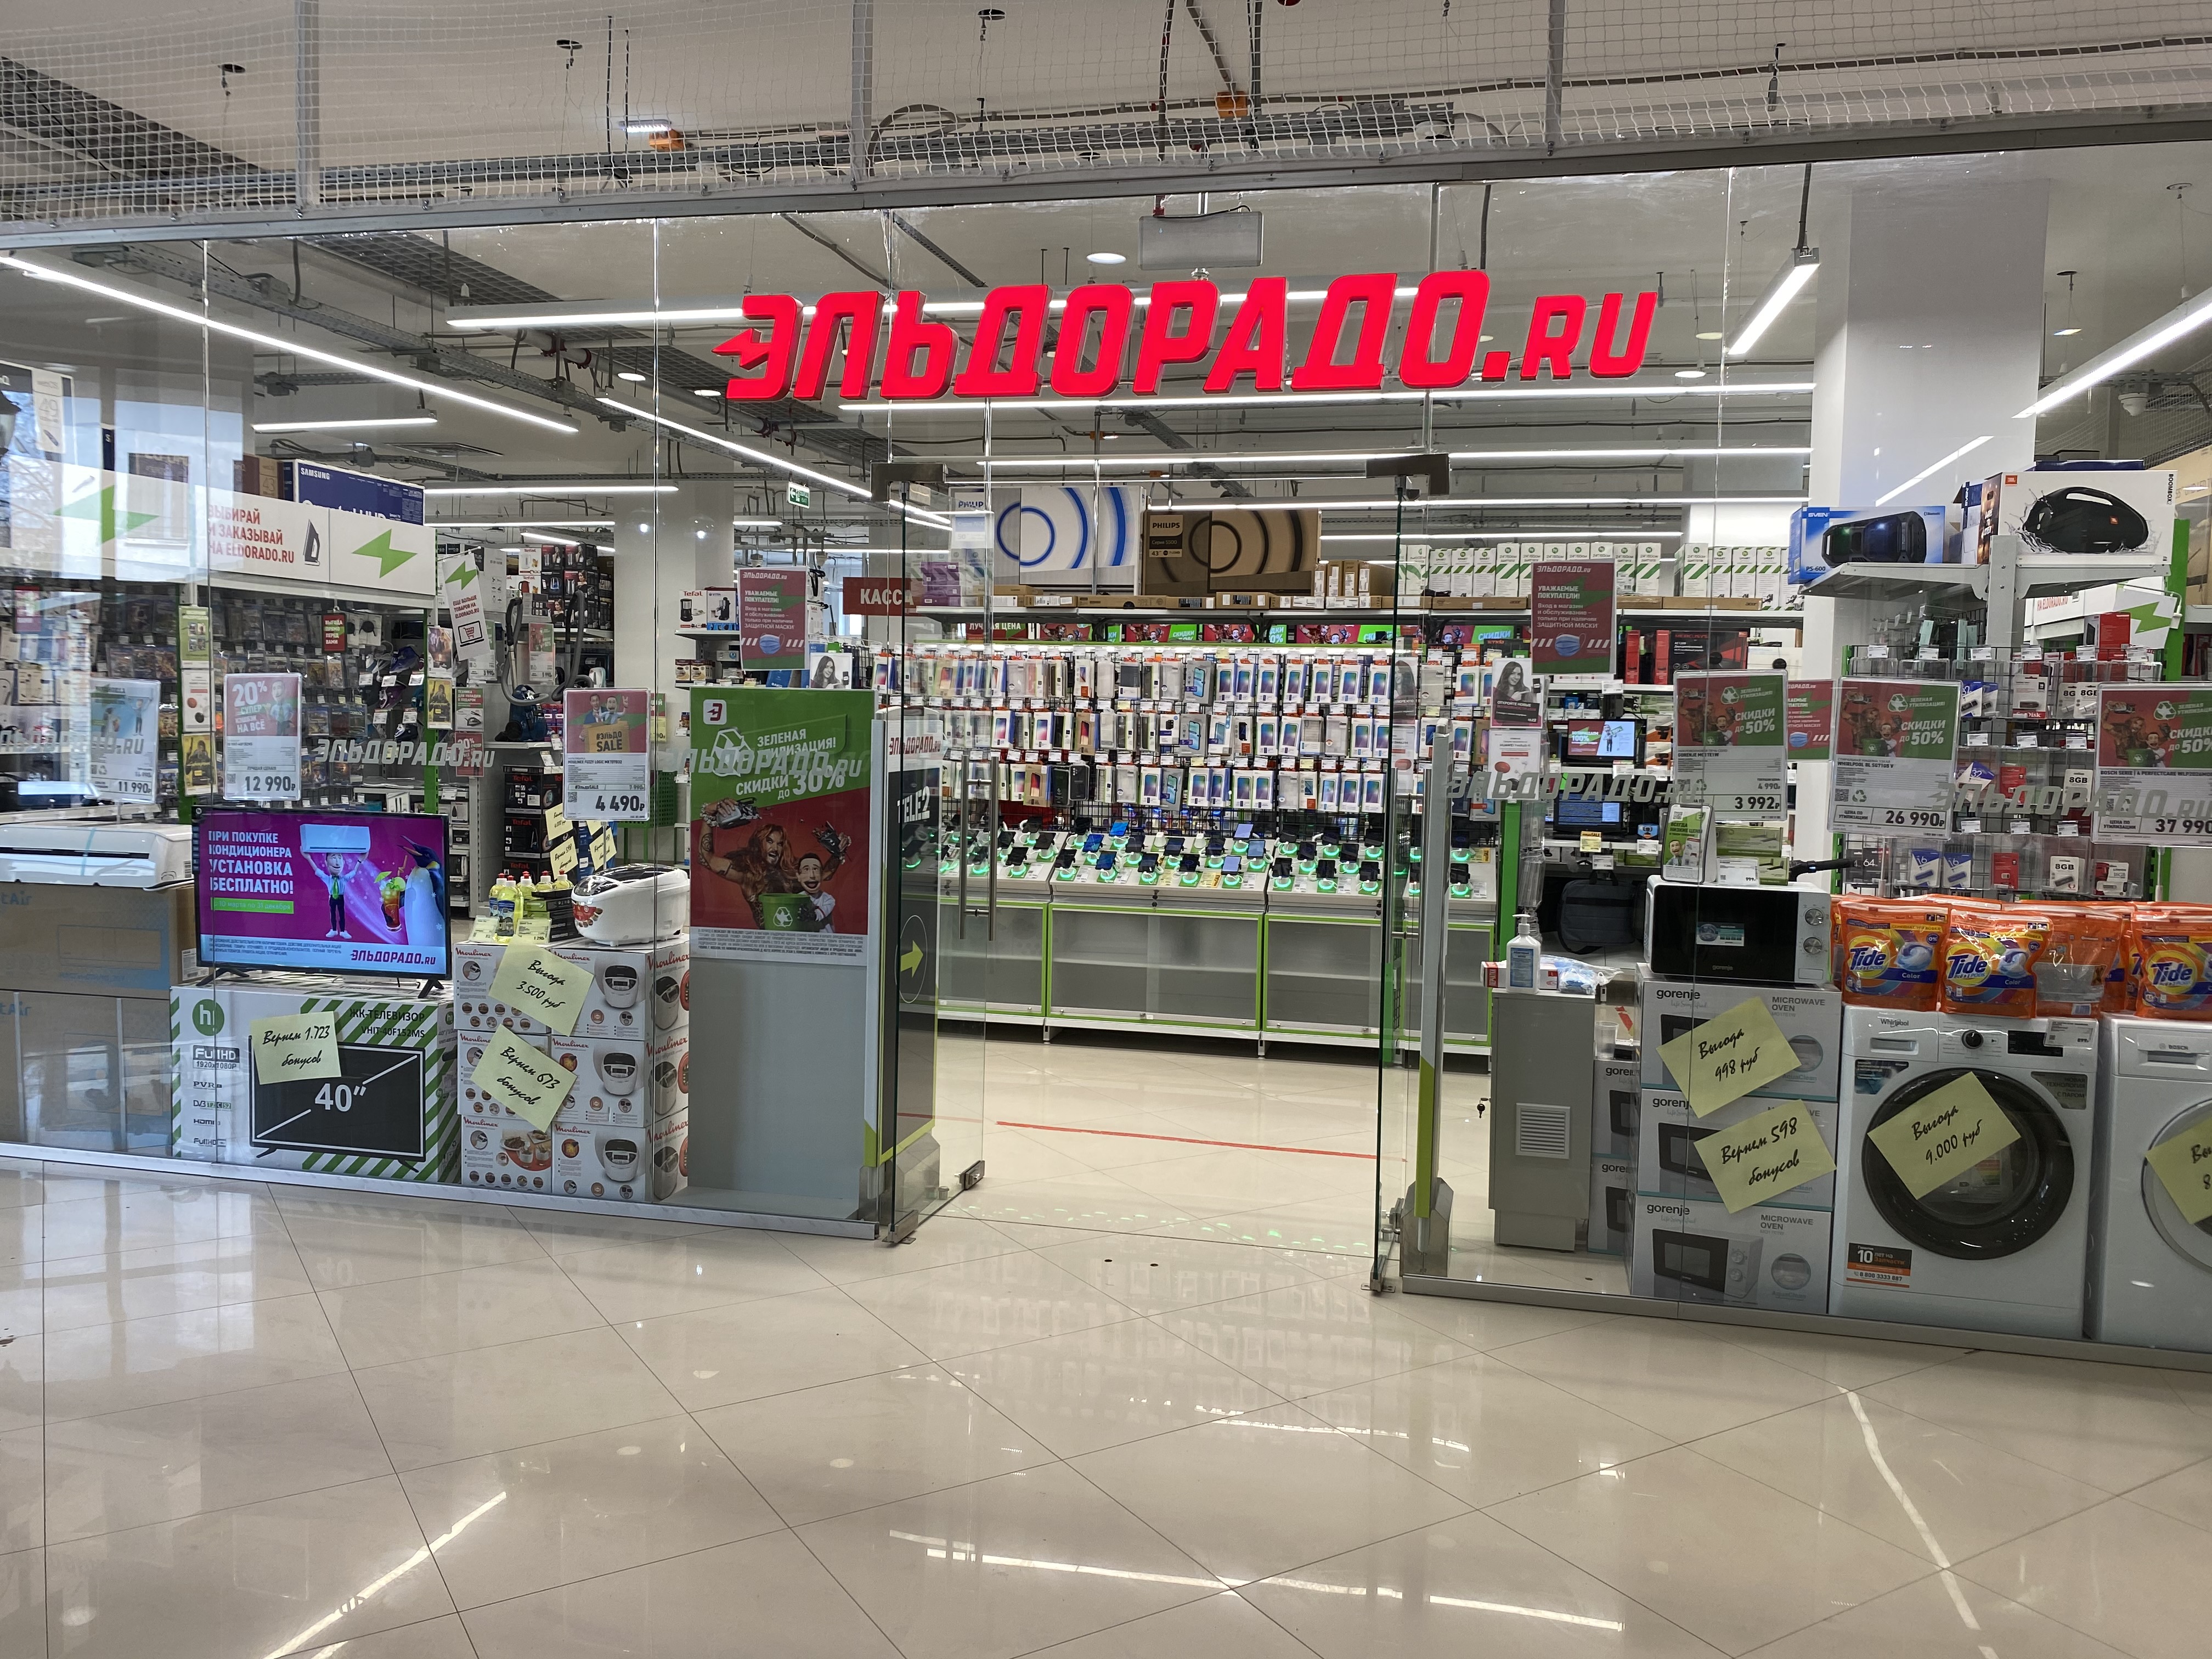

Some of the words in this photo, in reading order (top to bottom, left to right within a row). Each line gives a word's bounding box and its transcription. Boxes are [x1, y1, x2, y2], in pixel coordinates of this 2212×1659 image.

[713, 269, 1657, 401] ЭЛЬДОРАДО.RU
[300, 467, 330, 480] SAMSUNG
[209, 504, 261, 524] ВЫБИРАЙ
[1152, 522, 1181, 530] PHILIPS
[219, 524, 283, 545] ЗАКАЗЫВАЙ
[226, 543, 295, 564] ELDORADO.RU
[742, 572, 788, 580] ЭЛЬДОРАДО.RU
[1536, 565, 1592, 573] ЭЛЬДОРАДО.RU
[860, 588, 914, 606] КАССА
[1001, 623, 1022, 631] ЦЕНА
[1172, 629, 1195, 639] СКИДКИ
[1478, 630, 1511, 640] СКИДКИ
[232, 680, 268, 707] 20%
[240, 703, 263, 715] СУПЕР
[1735, 708, 1775, 721] СКИДКИ
[236, 723, 249, 734] НА
[249, 718, 266, 732] ВСЁ
[1745, 719, 1775, 735] 50%
[1900, 719, 1946, 731] СКИДКИ
[596, 730, 623, 741] #ЭЛЬДО
[757, 728, 806, 748] ЗЕЛЕНАЯ
[1899, 735, 1910, 743] до
[1910, 730, 1944, 746] 50%
[311, 738, 495, 768] ЭЛЬДОРАДО.RU
[596, 740, 623, 752] SALE
[2168, 743, 2180, 752] до
[792, 764, 845, 796] 30%
[1971, 769, 1982, 778] 32
[118, 781, 128, 792] 11
[245, 776, 261, 792] 12
[735, 774, 789, 796] СКИДКИ
[1443, 770, 1697, 804] ЭЛЬДОРАДО.RU
[595, 795, 606, 811] 4
[897, 786, 930, 823] TELE2
[1734, 796, 1743, 810] 3
[1885, 810, 1905, 825] 26
[2155, 819, 2176, 833] 37
[208, 830, 229, 842] ПРИ
[232, 831, 279, 844] ПОКУПКЕ
[208, 844, 292, 858] КОНДИЦИОНЕРА
[208, 859, 293, 877] УСТАНОВКА
[1863, 858, 1875, 867] 64
[1916, 856, 1927, 866] 16
[1949, 857, 1960, 866] 16
[210, 877, 294, 895] БЕСПЛАТНО!
[264, 903, 291, 912] декабря
[349, 950, 437, 966] ЭЛЬДОРАДО.RU
[455, 947, 493, 957] Moulinex
[1850, 947, 1886, 971] Tide
[527, 960, 566, 985] Выгода
[1948, 956, 1988, 980] Tide
[2151, 962, 2193, 985] Tide
[515, 980, 546, 1000] 3.500
[540, 997, 566, 1008] руб
[1656, 989, 1701, 1001] gorenje
[1772, 996, 1826, 1006] MICROWAVE
[349, 1008, 425, 1022] ЖК-ТЕЛЕВИЗОР
[1880, 1018, 1909, 1028] Whirlpool
[262, 1030, 301, 1046] Вернем
[304, 1025, 331, 1041] 1.723
[552, 1037, 589, 1048] Moulinex
[1698, 1028, 1745, 1059] Выгода
[281, 1049, 323, 1070] бонусов
[500, 1046, 537, 1076] Вернем
[1714, 1059, 1736, 1082] 998
[1740, 1046, 1760, 1074] руб
[496, 1076, 541, 1105] бонусов
[1652, 1098, 1689, 1110] gorenj
[463, 1116, 499, 1127] Moulinex
[1911, 1105, 1959, 1141] Выгода
[554, 1123, 592, 1135] Moulinex
[1720, 1137, 1768, 1165] Вернем
[1770, 1116, 1798, 1143] 598
[1925, 1134, 1958, 1165] 9.000
[1962, 1119, 1983, 1148] руб
[1748, 1148, 1800, 1186] бонусов
[1647, 1204, 1690, 1216] gorenje
[1760, 1214, 1814, 1226] MICROWAVE
[1760, 1222, 1784, 1231] OVEN
[1857, 1250, 1873, 1263] 10
[1874, 1256, 1905, 1265] Запчасти
